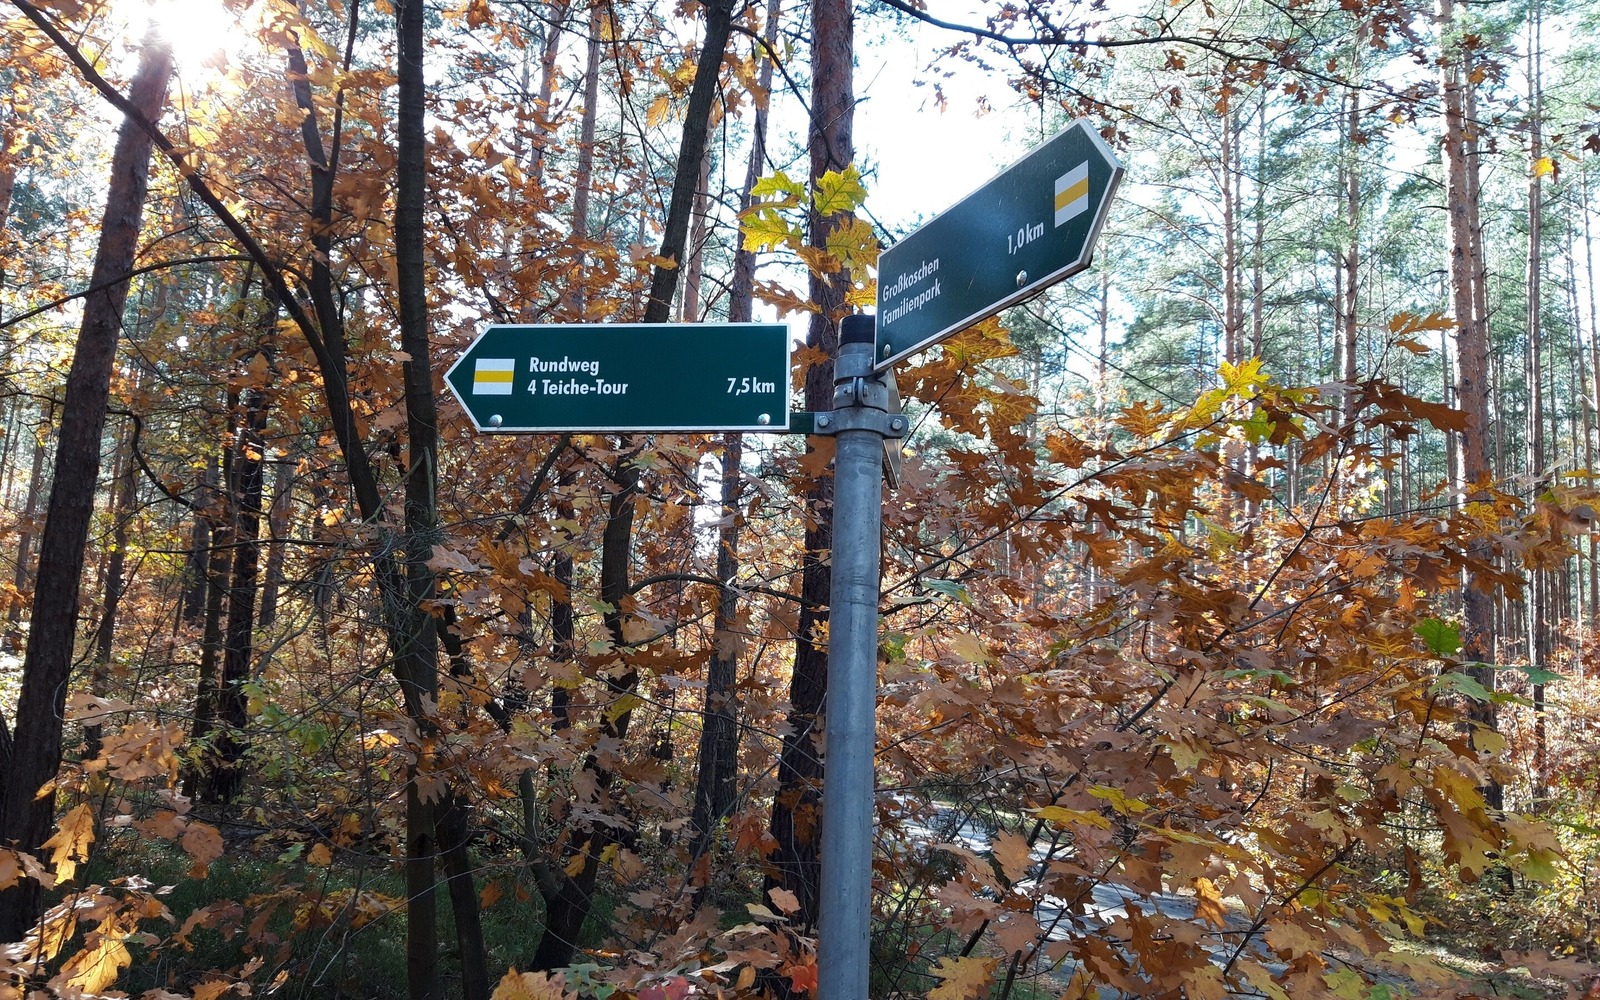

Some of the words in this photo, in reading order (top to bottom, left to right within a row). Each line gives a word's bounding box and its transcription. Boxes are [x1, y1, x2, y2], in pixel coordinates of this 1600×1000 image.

[882, 258, 939, 302] Großkoschen
[882, 278, 941, 327] Familienpark
[529, 356, 599, 376] Rundweg
[527, 379, 537, 395] 4
[542, 378, 629, 395] Teiche-Tour
